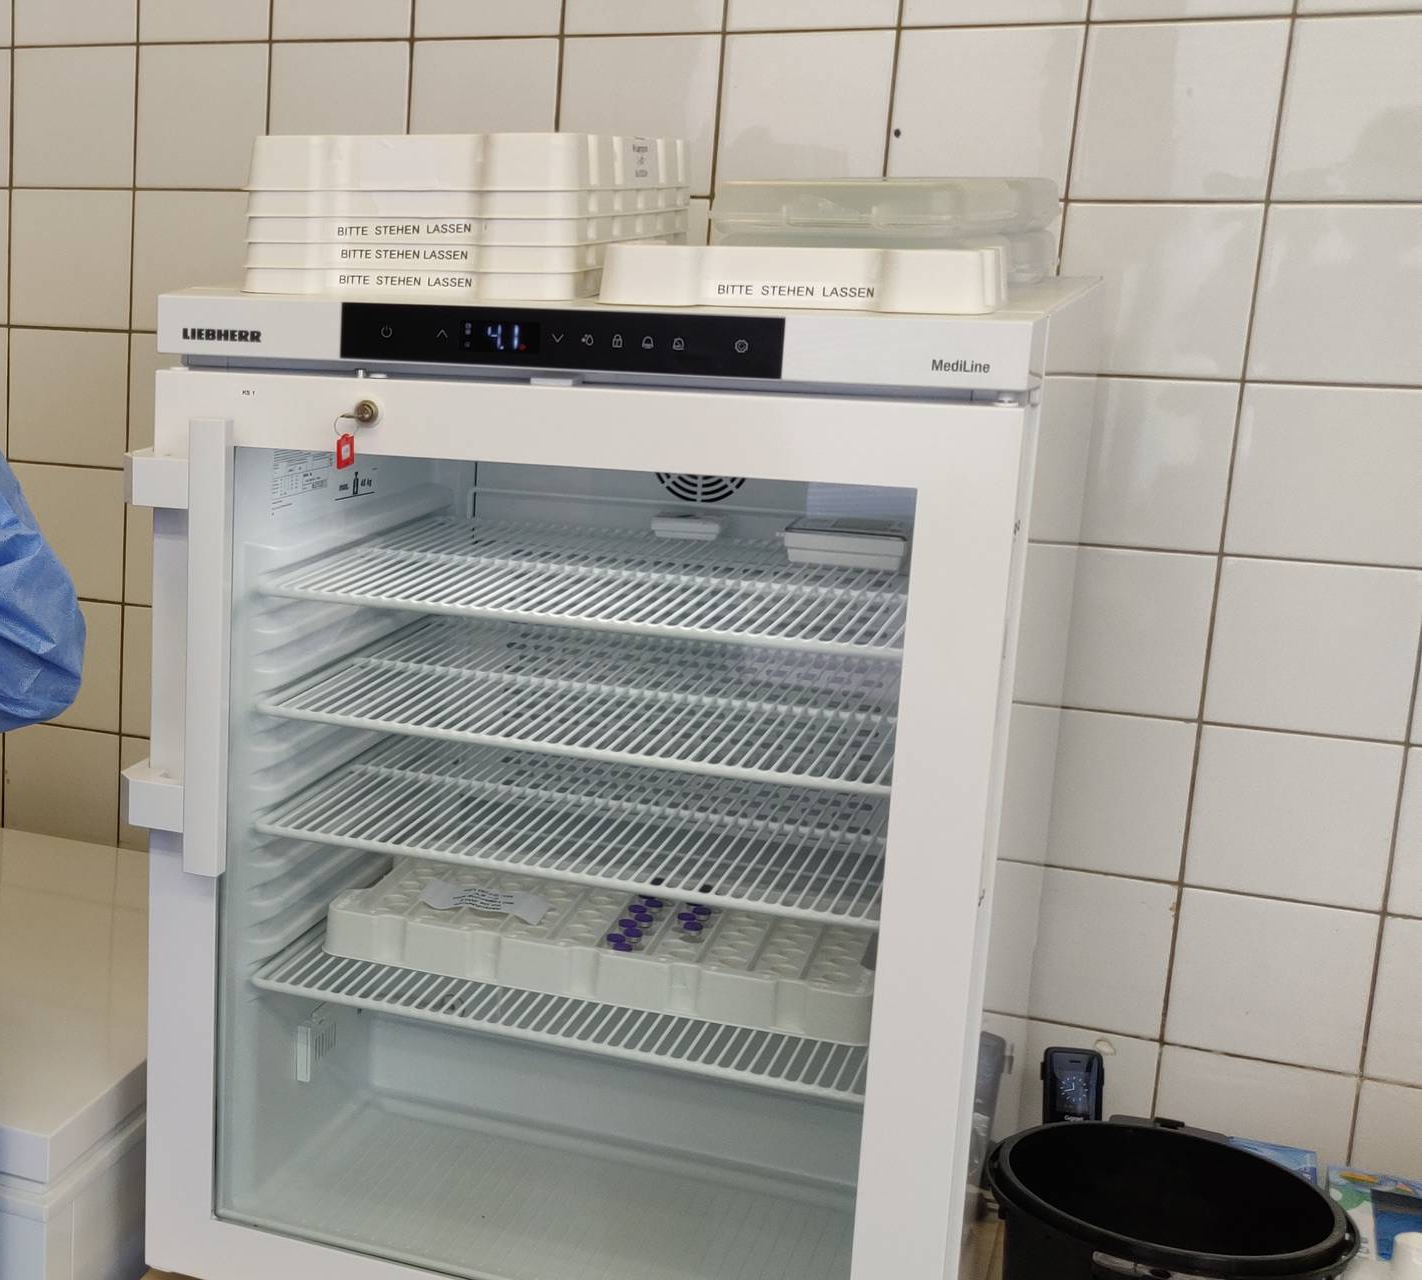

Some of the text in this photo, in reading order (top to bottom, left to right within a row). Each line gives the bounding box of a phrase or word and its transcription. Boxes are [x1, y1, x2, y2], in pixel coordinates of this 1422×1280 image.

[337, 223, 472, 236] BITTE STEHEN LASSEN
[340, 249, 468, 260] BITTE STEHEN LASSEN
[338, 274, 472, 288] BITTE STEHEN LASSEN
[717, 284, 875, 298] BITTE STEHEN LASSEN
[182, 327, 262, 343] LIEBHERR
[931, 359, 991, 374] MediLine
